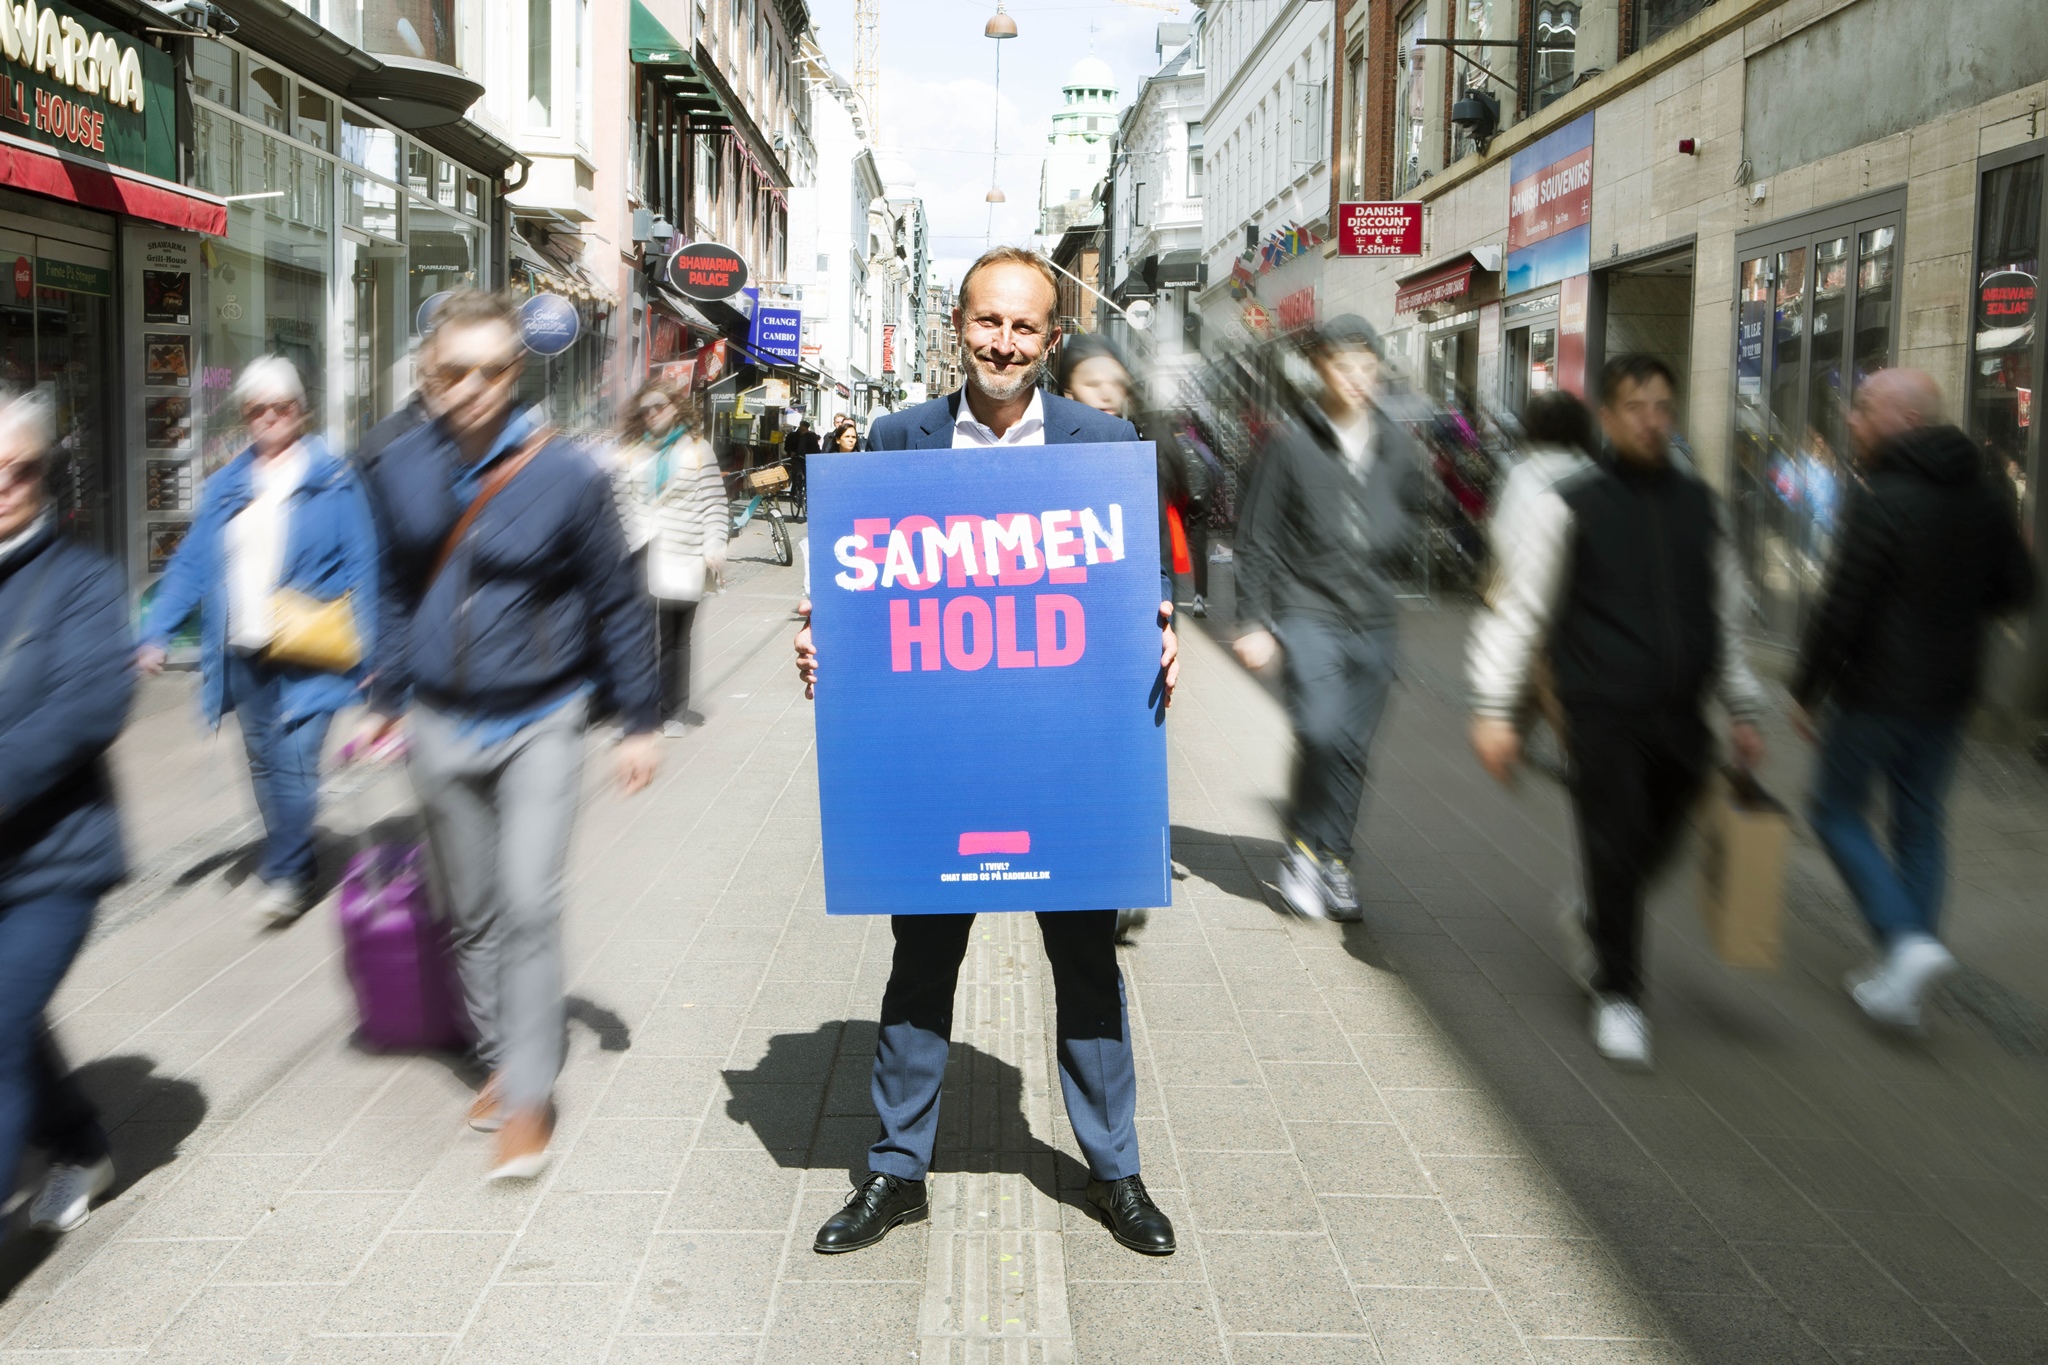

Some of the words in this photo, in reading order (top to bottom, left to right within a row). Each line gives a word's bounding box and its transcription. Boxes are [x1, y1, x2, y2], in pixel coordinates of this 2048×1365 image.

[35, 87, 105, 152] HOUSE
[1511, 184, 1540, 219] DANISH
[1541, 159, 1590, 205] SOUVENIRS
[1355, 206, 1404, 217] DANISH
[1347, 217, 1412, 227] DISCOUNT
[1353, 226, 1406, 236] Souvenir
[1375, 236, 1383, 244] &
[147, 241, 187, 253] SHAWARMA
[1356, 244, 1401, 254] T-Shirts
[146, 254, 188, 265] Grill-House
[679, 255, 740, 273] SHAWARMA
[689, 271, 730, 287] PALACE
[763, 316, 798, 327] CHANGE
[1750, 321, 1762, 338] LEJE
[763, 331, 796, 342] CAMBIO
[833, 503, 1126, 592] SAMMEN
[889, 593, 1086, 673] HOLD
[980, 862, 984, 871] I
[985, 862, 1010, 871] TVIVL?
[940, 873, 960, 882] CHAT
[961, 872, 979, 882] MED
[979, 872, 990, 881] OS
[991, 870, 1001, 881] PÅ
[1002, 871, 1051, 881] RADIKALE.DK
